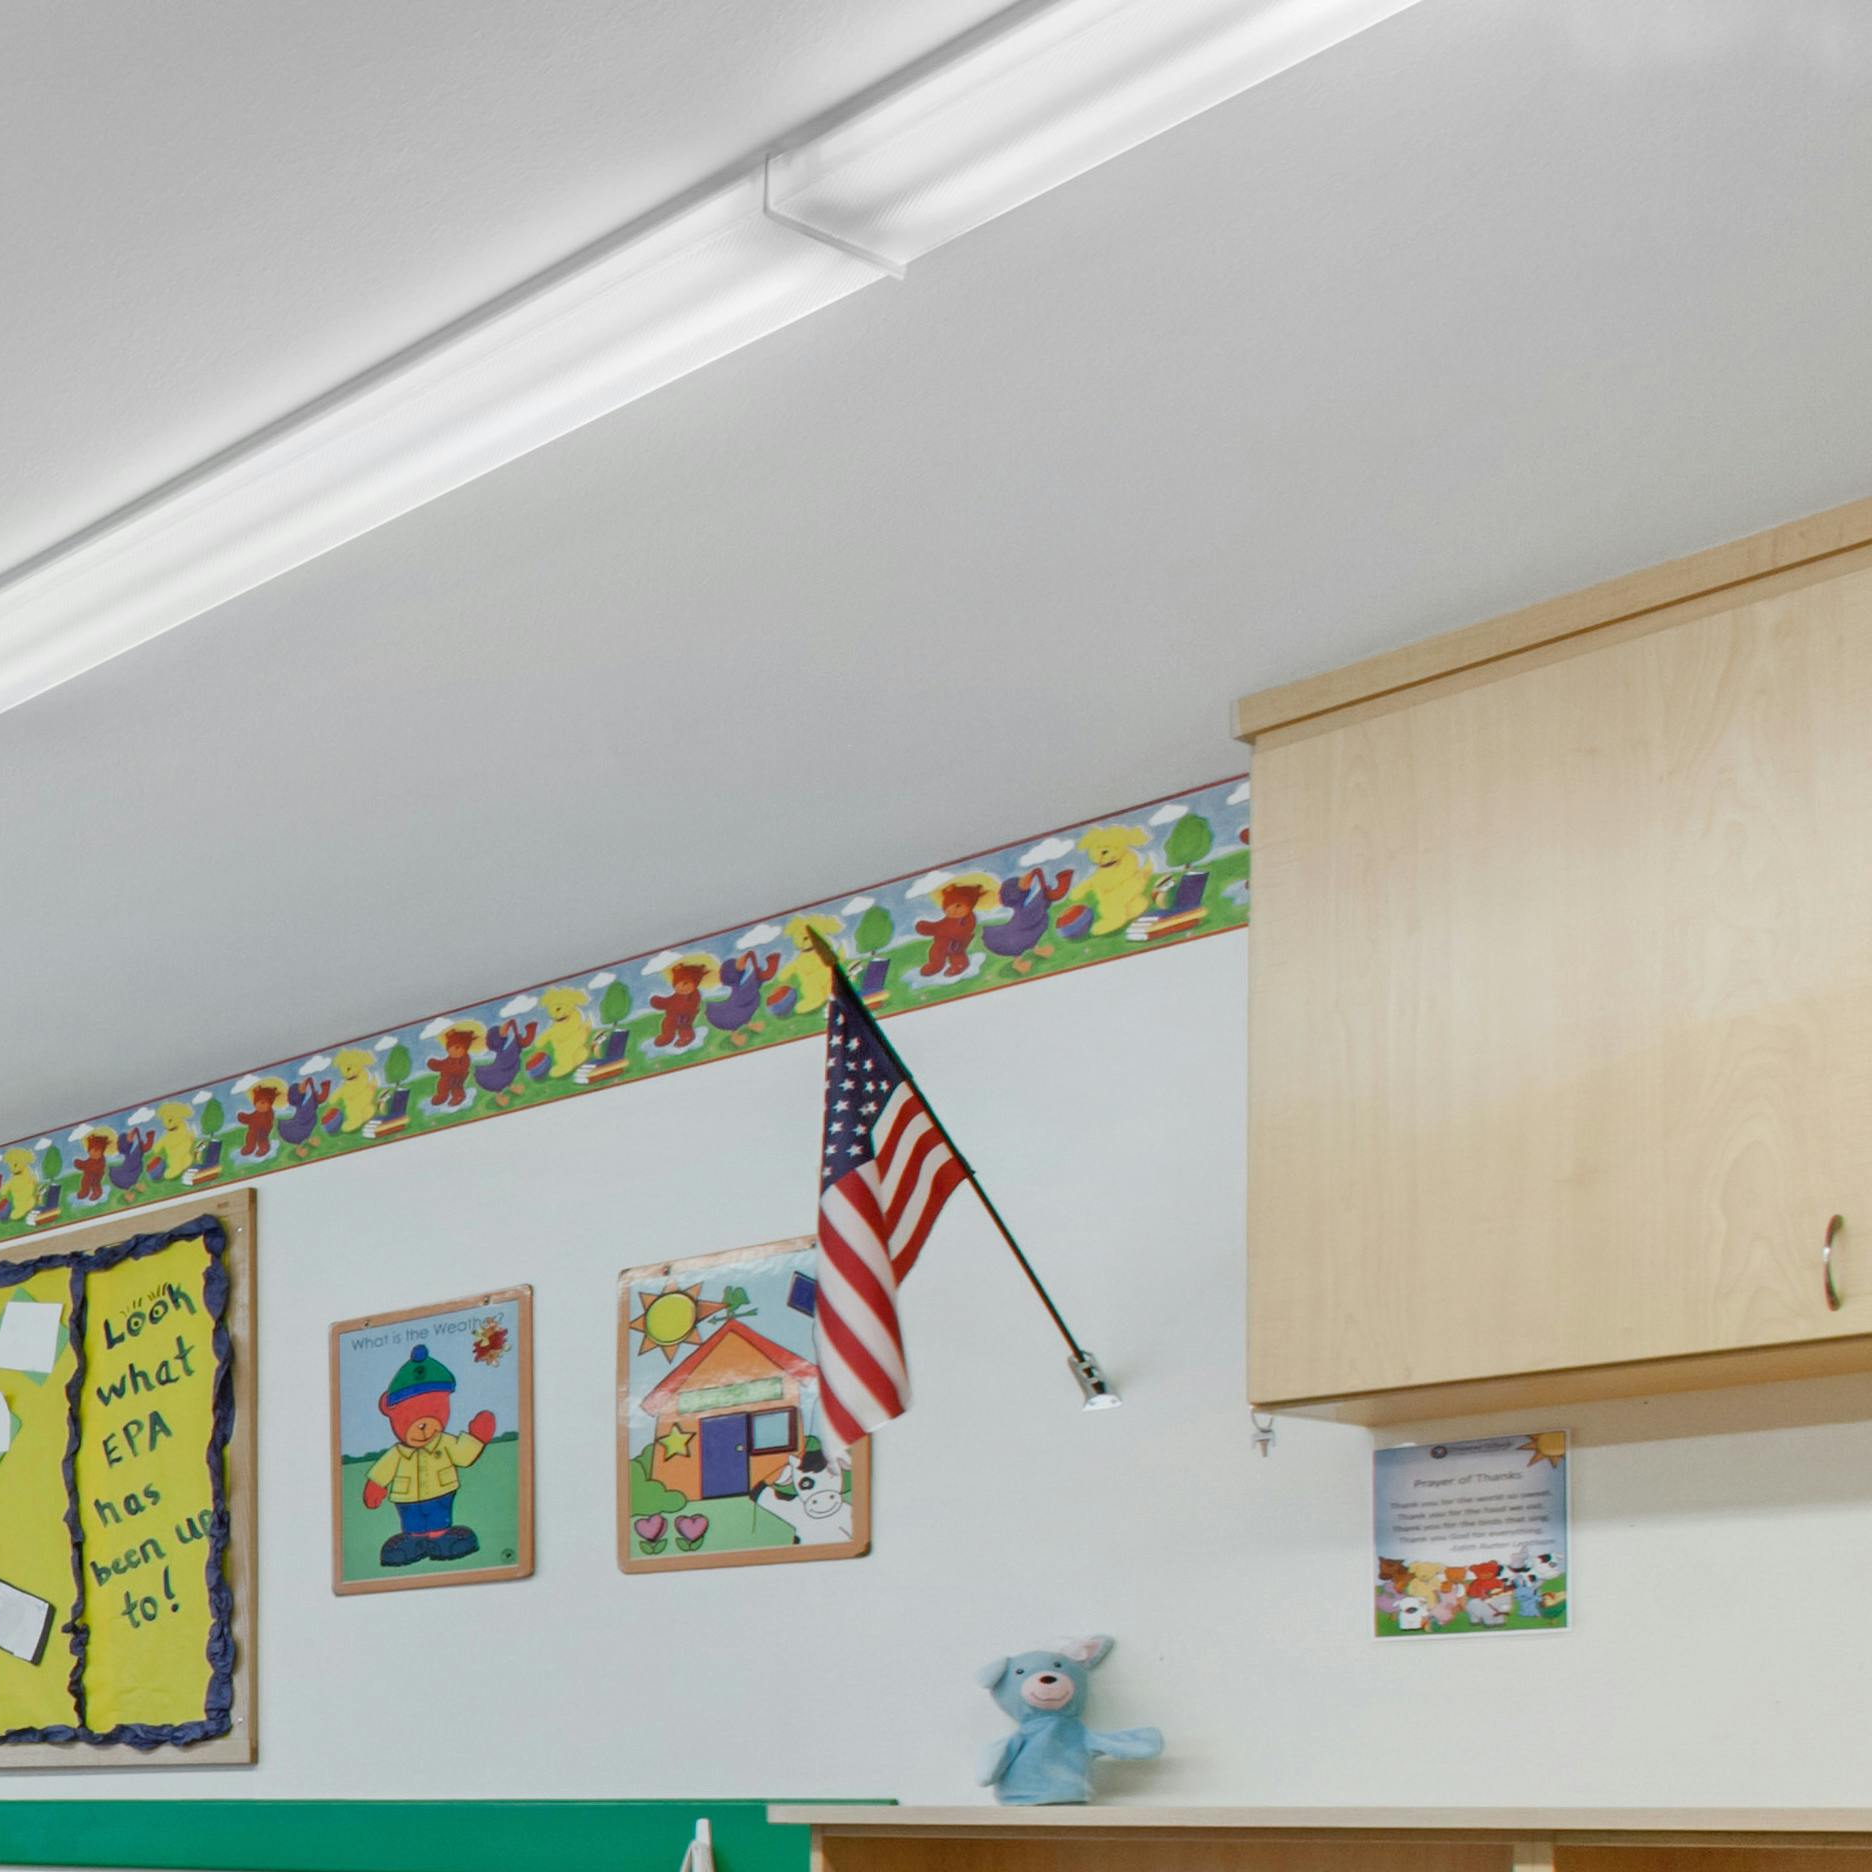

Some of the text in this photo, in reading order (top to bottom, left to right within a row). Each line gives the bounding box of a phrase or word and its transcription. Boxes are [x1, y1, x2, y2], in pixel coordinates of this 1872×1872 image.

[103, 1282, 197, 1349] Look
[350, 1335, 389, 1352] What
[391, 1330, 402, 1345] is
[405, 1328, 429, 1342] the
[96, 1335, 195, 1407] what
[102, 1411, 172, 1469] EPA
[93, 1483, 162, 1528] has
[89, 1538, 167, 1588] been
[121, 1566, 181, 1630] to!
